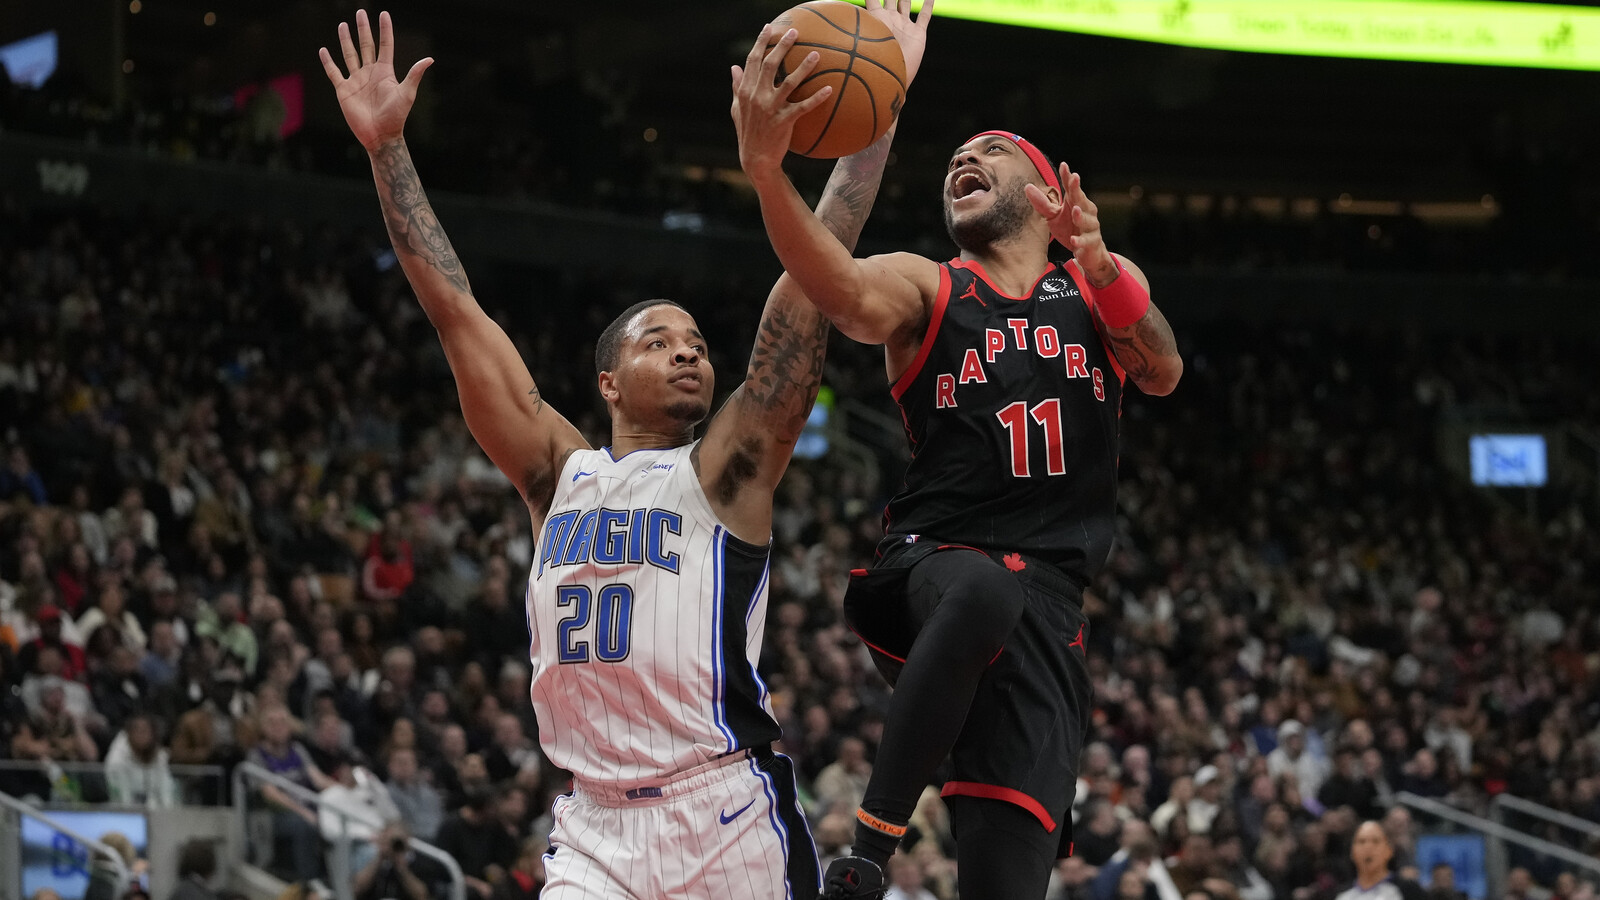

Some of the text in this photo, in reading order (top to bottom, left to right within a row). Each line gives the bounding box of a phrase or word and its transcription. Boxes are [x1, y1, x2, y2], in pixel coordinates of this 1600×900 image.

[1038, 289, 1079, 302] Sun Life
[936, 318, 1105, 409] RAPTORS
[995, 398, 1066, 477] 11
[537, 507, 682, 581] MAGIC
[557, 583, 634, 664] 20
